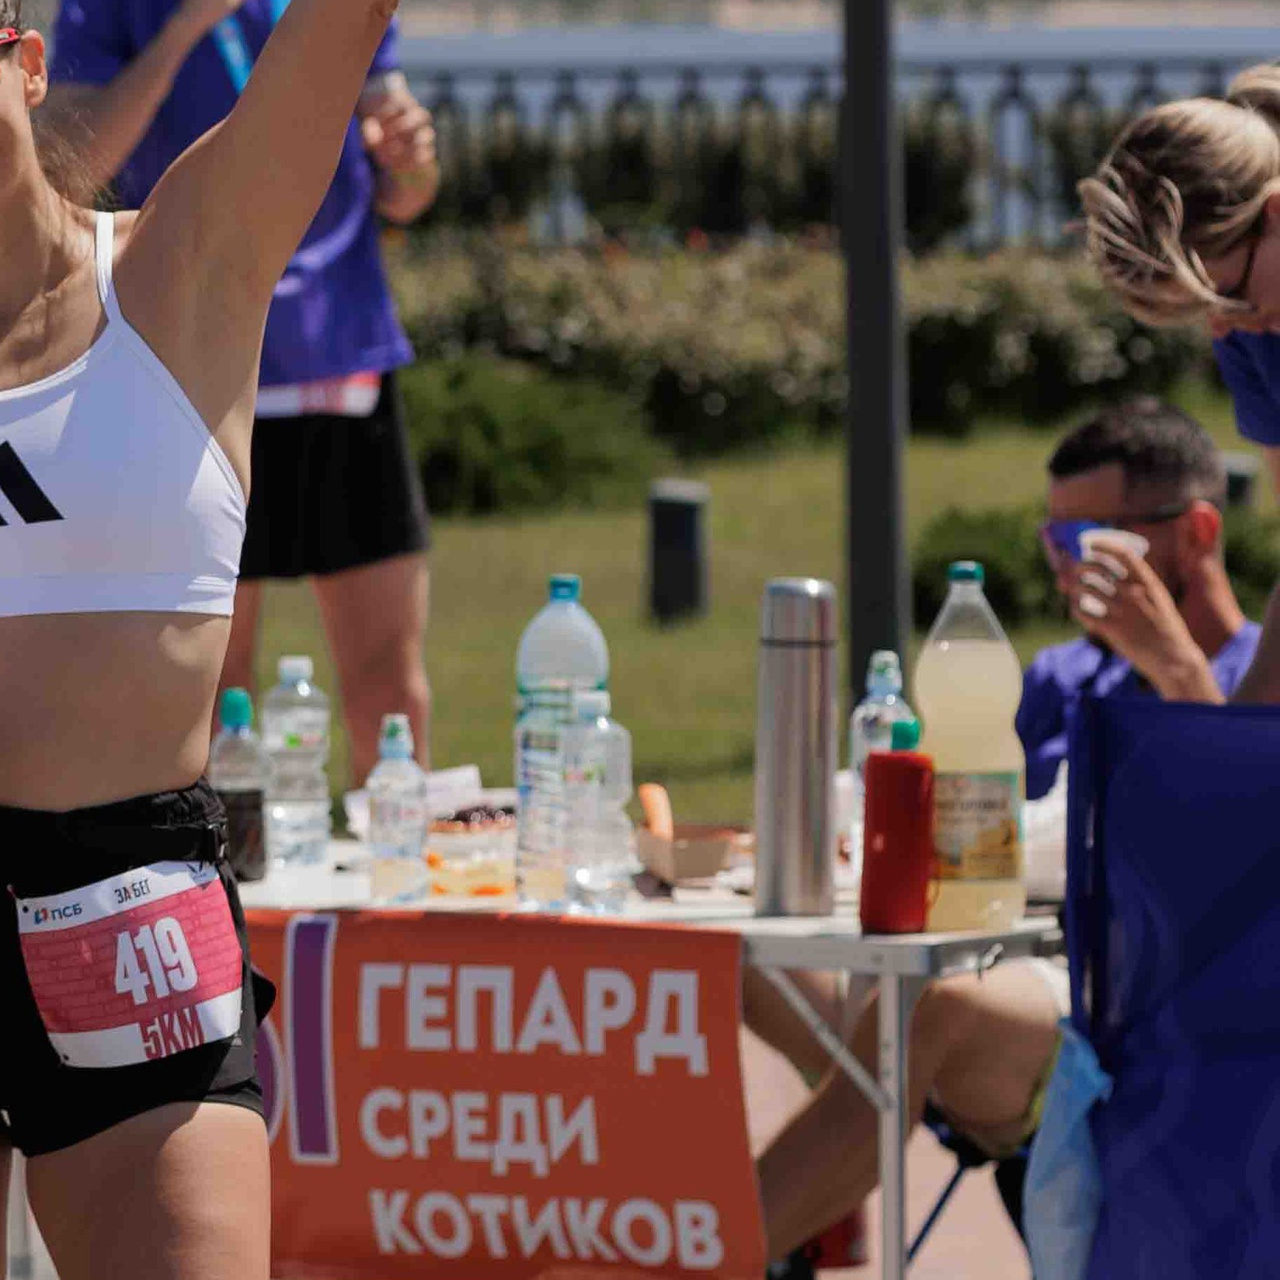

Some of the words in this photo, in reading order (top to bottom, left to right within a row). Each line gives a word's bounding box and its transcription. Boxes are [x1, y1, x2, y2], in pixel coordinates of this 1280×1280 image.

[50, 902, 84, 921] ПСБ
[115, 916, 199, 1006] 419
[358, 962, 709, 1077] ГЕПАРД
[359, 1087, 600, 1178] СРЕДИ
[368, 1188, 725, 1270] КОТИКОВ
